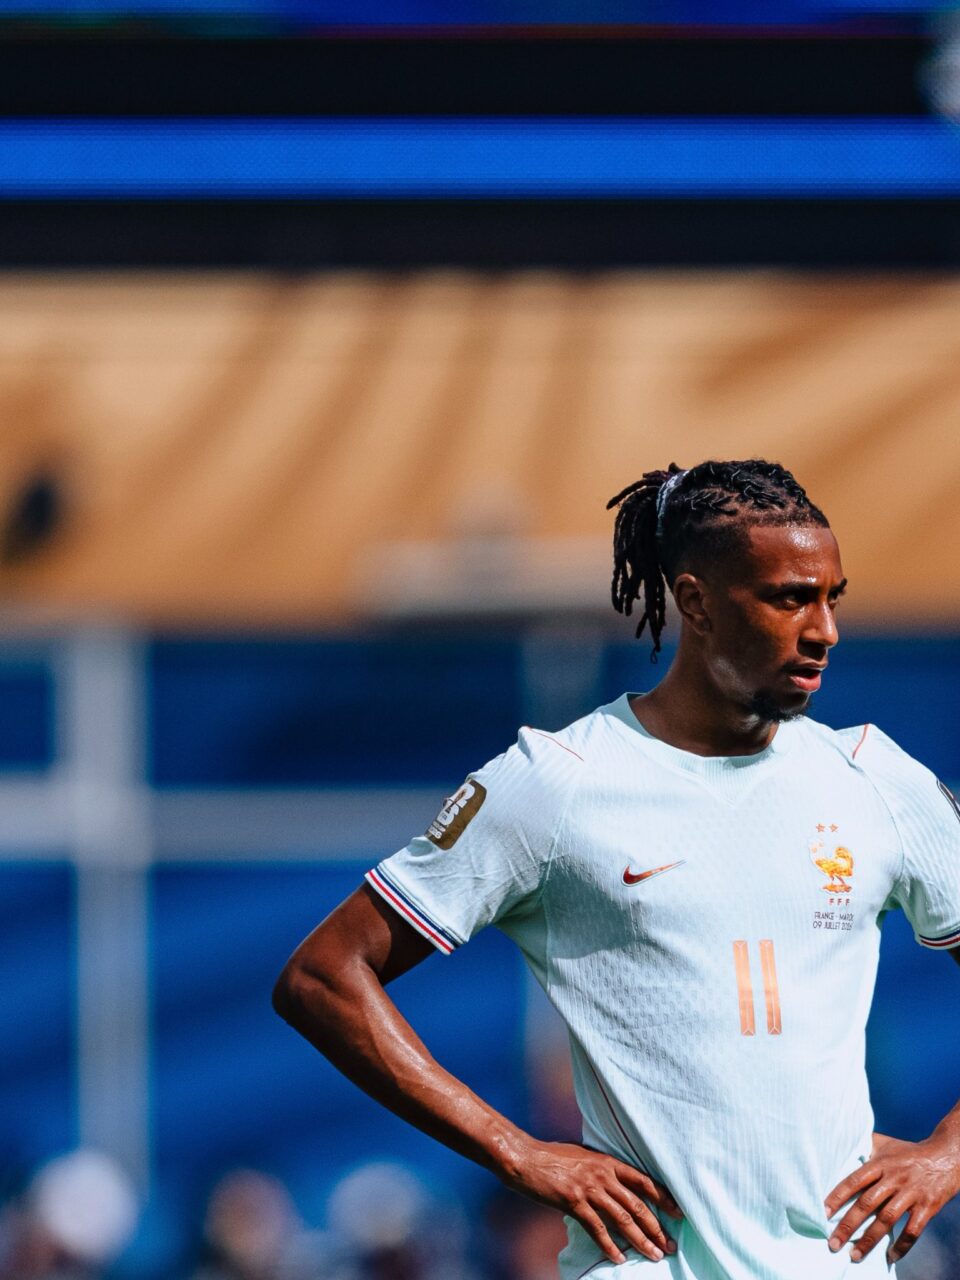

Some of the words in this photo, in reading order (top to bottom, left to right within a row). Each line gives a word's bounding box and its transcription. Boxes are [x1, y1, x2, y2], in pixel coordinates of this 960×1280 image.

[814, 911, 835, 921] FRANCE
[813, 920, 822, 929] 09
[732, 939, 782, 1036] 11
